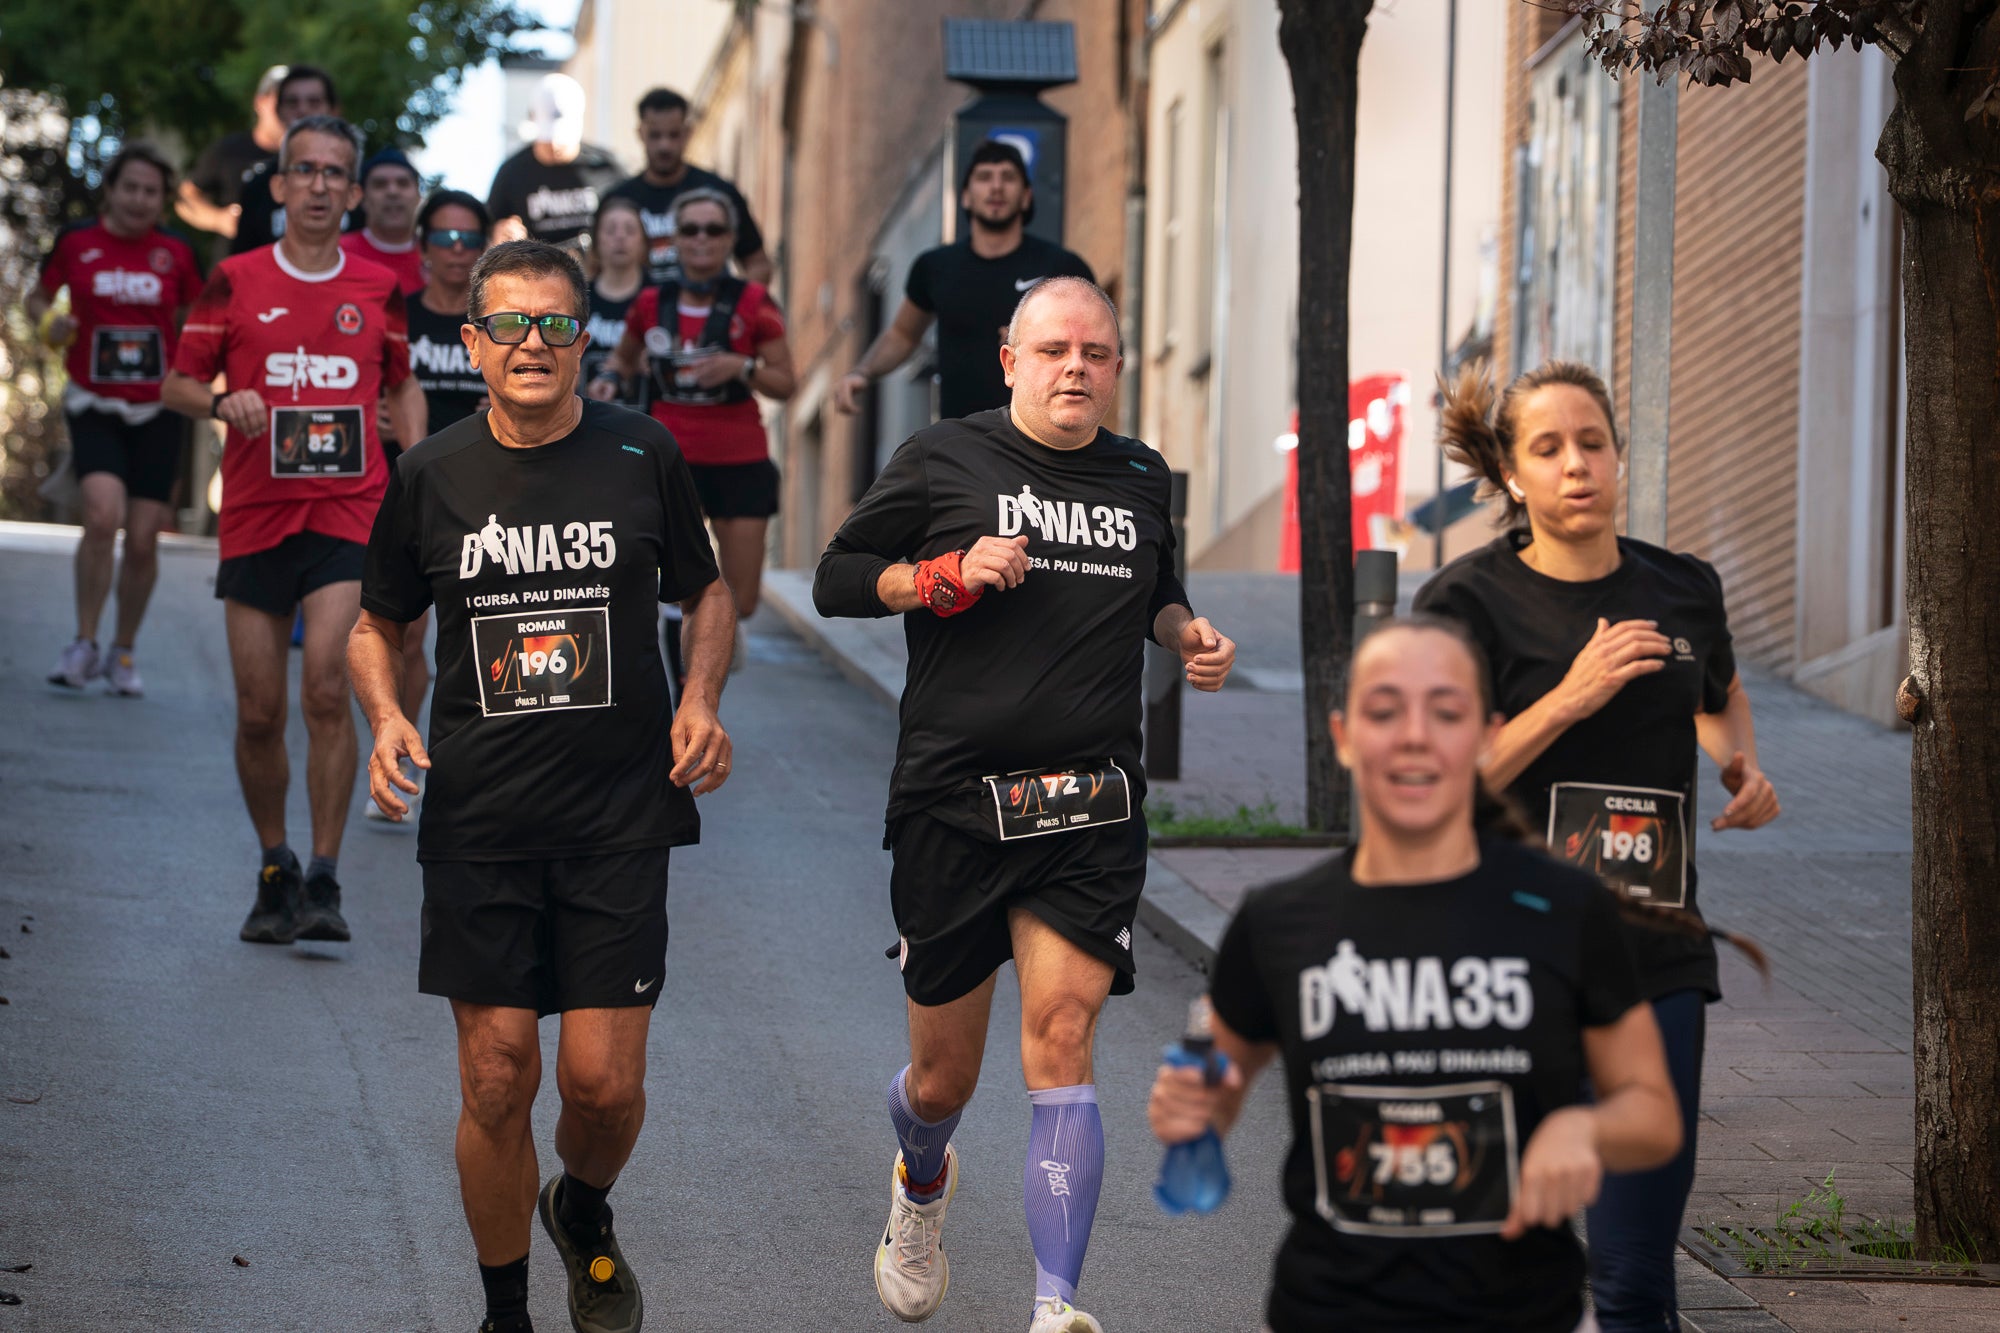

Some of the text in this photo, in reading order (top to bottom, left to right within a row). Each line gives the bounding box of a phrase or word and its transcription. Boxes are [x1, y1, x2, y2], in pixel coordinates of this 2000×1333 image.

[308, 433, 336, 453] 82
[1027, 556, 1133, 579] RSA PAU DINARÈS
[473, 593, 519, 608] CURSA
[523, 590, 550, 604] PAU
[553, 584, 611, 601] DINARÈS
[517, 619, 566, 633] ROMAN
[518, 649, 568, 677] 196
[1041, 775, 1080, 798] 72
[1604, 796, 1657, 813] CECILIA
[1601, 829, 1653, 863] 198
[1322, 1051, 1391, 1080] CURSA
[1393, 1049, 1437, 1073] PAU
[1368, 1142, 1457, 1185] 755
